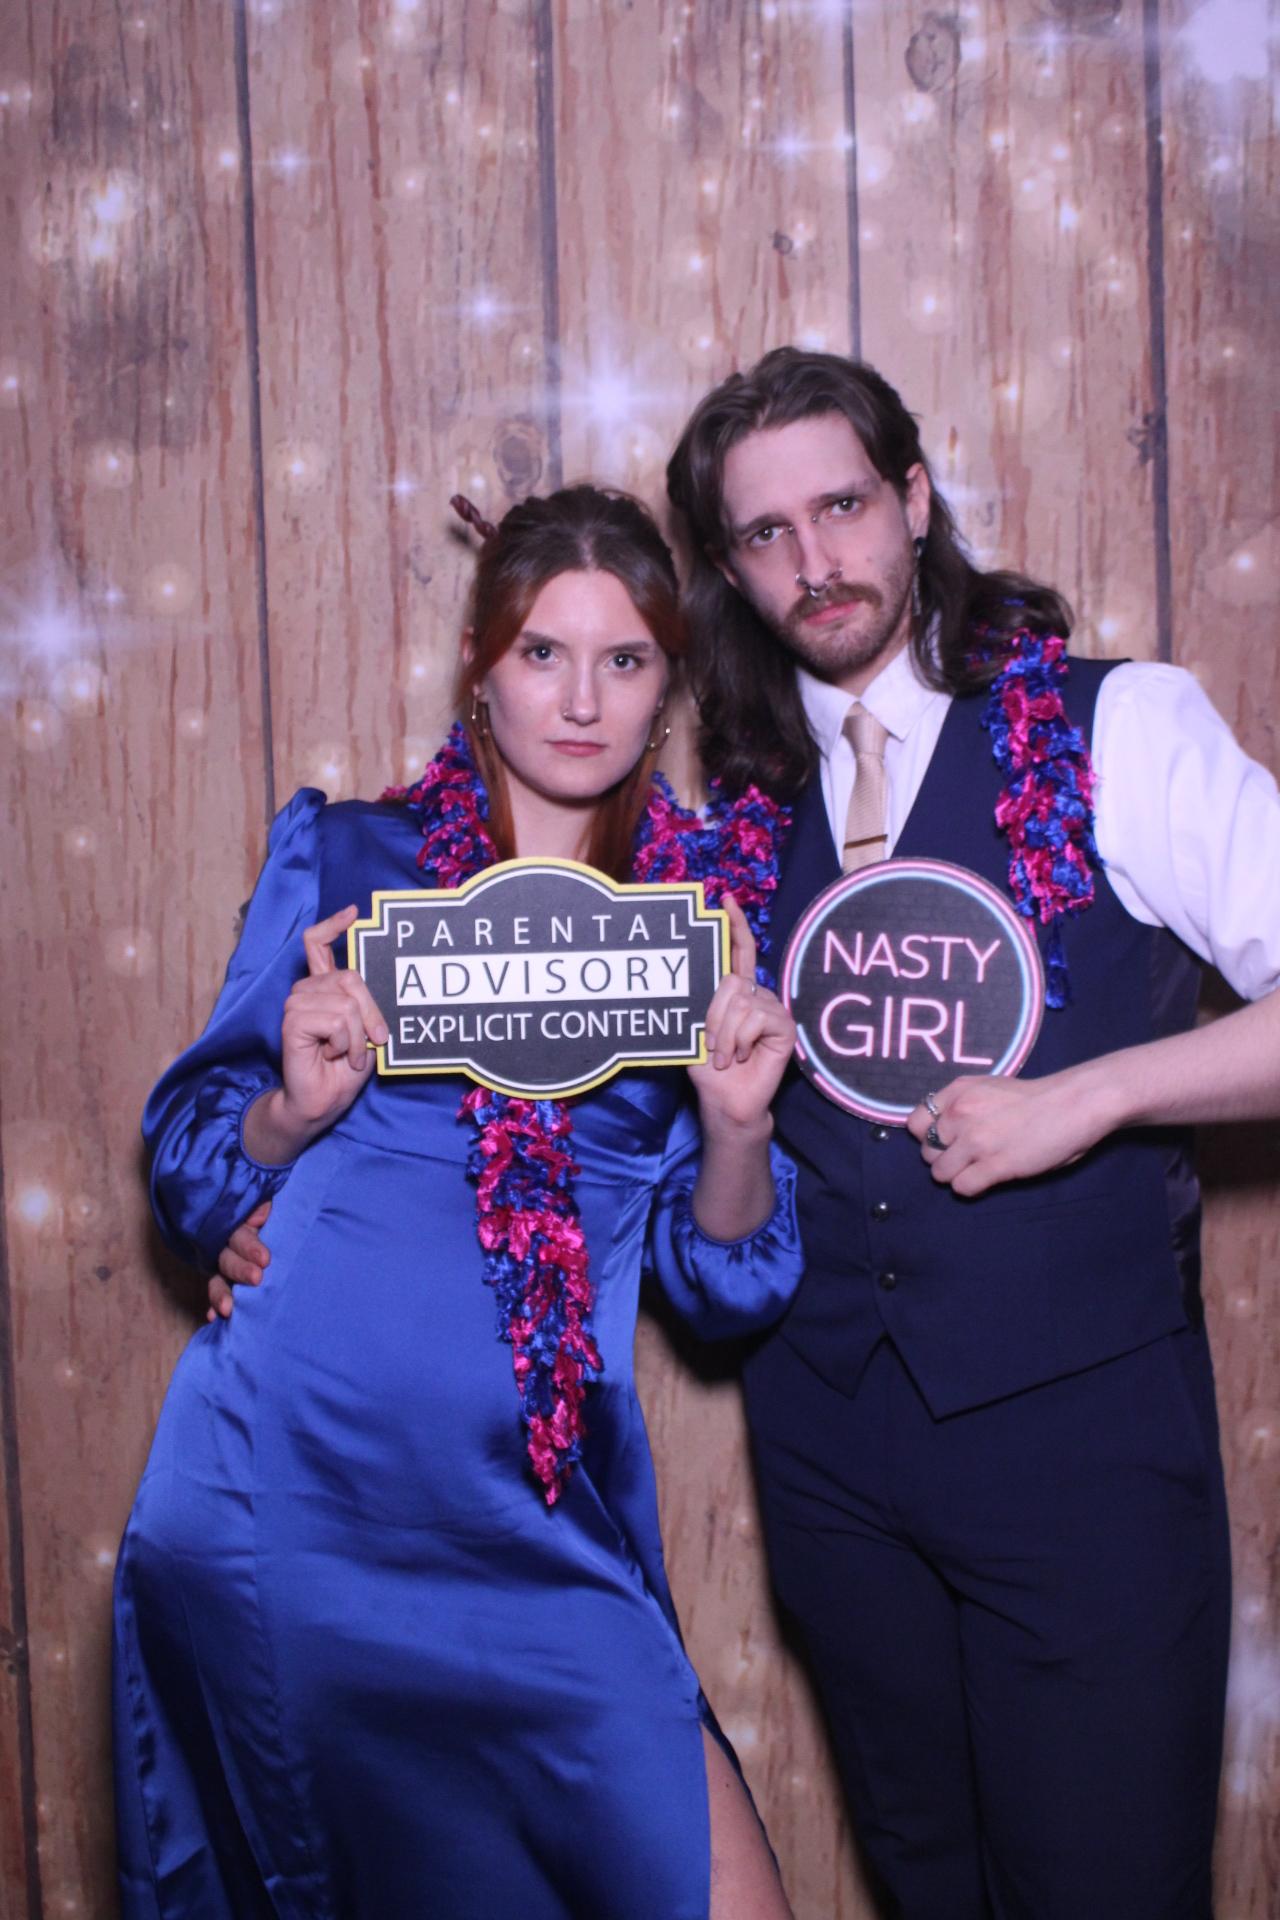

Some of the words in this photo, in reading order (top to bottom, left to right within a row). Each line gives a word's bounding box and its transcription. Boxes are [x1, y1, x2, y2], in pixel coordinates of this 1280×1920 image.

[396, 913, 687, 948] PARENTAL
[398, 955, 687, 999] ADVISORY
[823, 929, 1001, 983] NASTY
[400, 1013, 532, 1044] EXPLICIT
[540, 1008, 689, 1039] CONTENT
[820, 993, 993, 1066] GIRL
